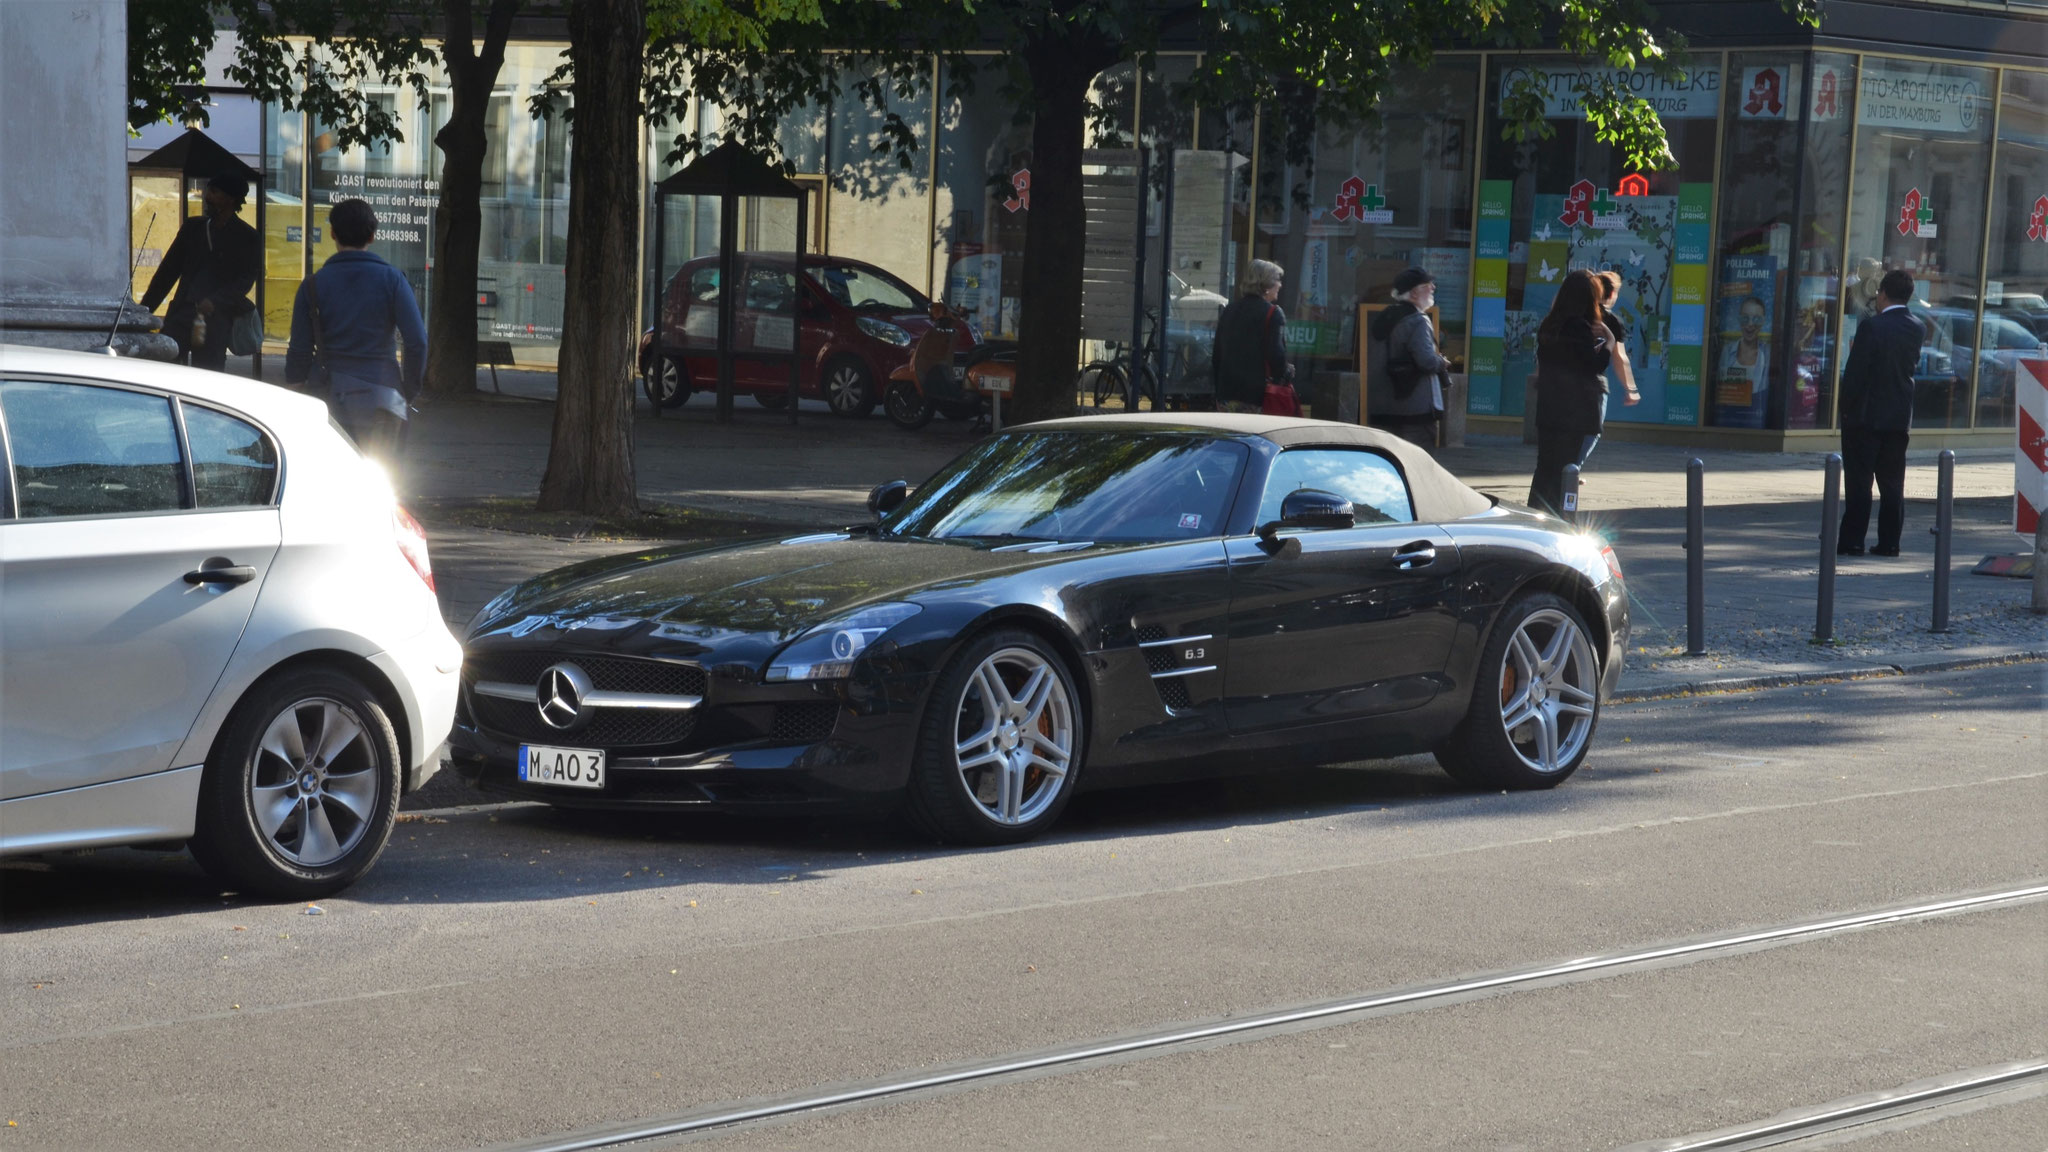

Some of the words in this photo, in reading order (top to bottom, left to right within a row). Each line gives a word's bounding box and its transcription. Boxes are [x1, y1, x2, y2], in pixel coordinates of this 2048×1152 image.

[1867, 104, 1878, 118] IN
[1880, 105, 1898, 120] DER
[1900, 106, 1942, 123] MAXBURG
[334, 174, 365, 187] J.GAST
[366, 176, 422, 190] revolutioniert
[424, 177, 440, 190] den
[376, 193, 389, 206] mit
[391, 194, 407, 207] den
[408, 195, 440, 208] Patente
[413, 213, 429, 225] und
[1680, 212, 1707, 220] SPRING!
[1726, 258, 1757, 268] POLLEN-
[1736, 268, 1770, 279] ALARM!
[1284, 326, 1317, 344] NEU
[1185, 648, 1205, 660] 6.3
[530, 750, 540, 778] M
[553, 753, 580, 782] AO
[586, 755, 600, 782] 3
